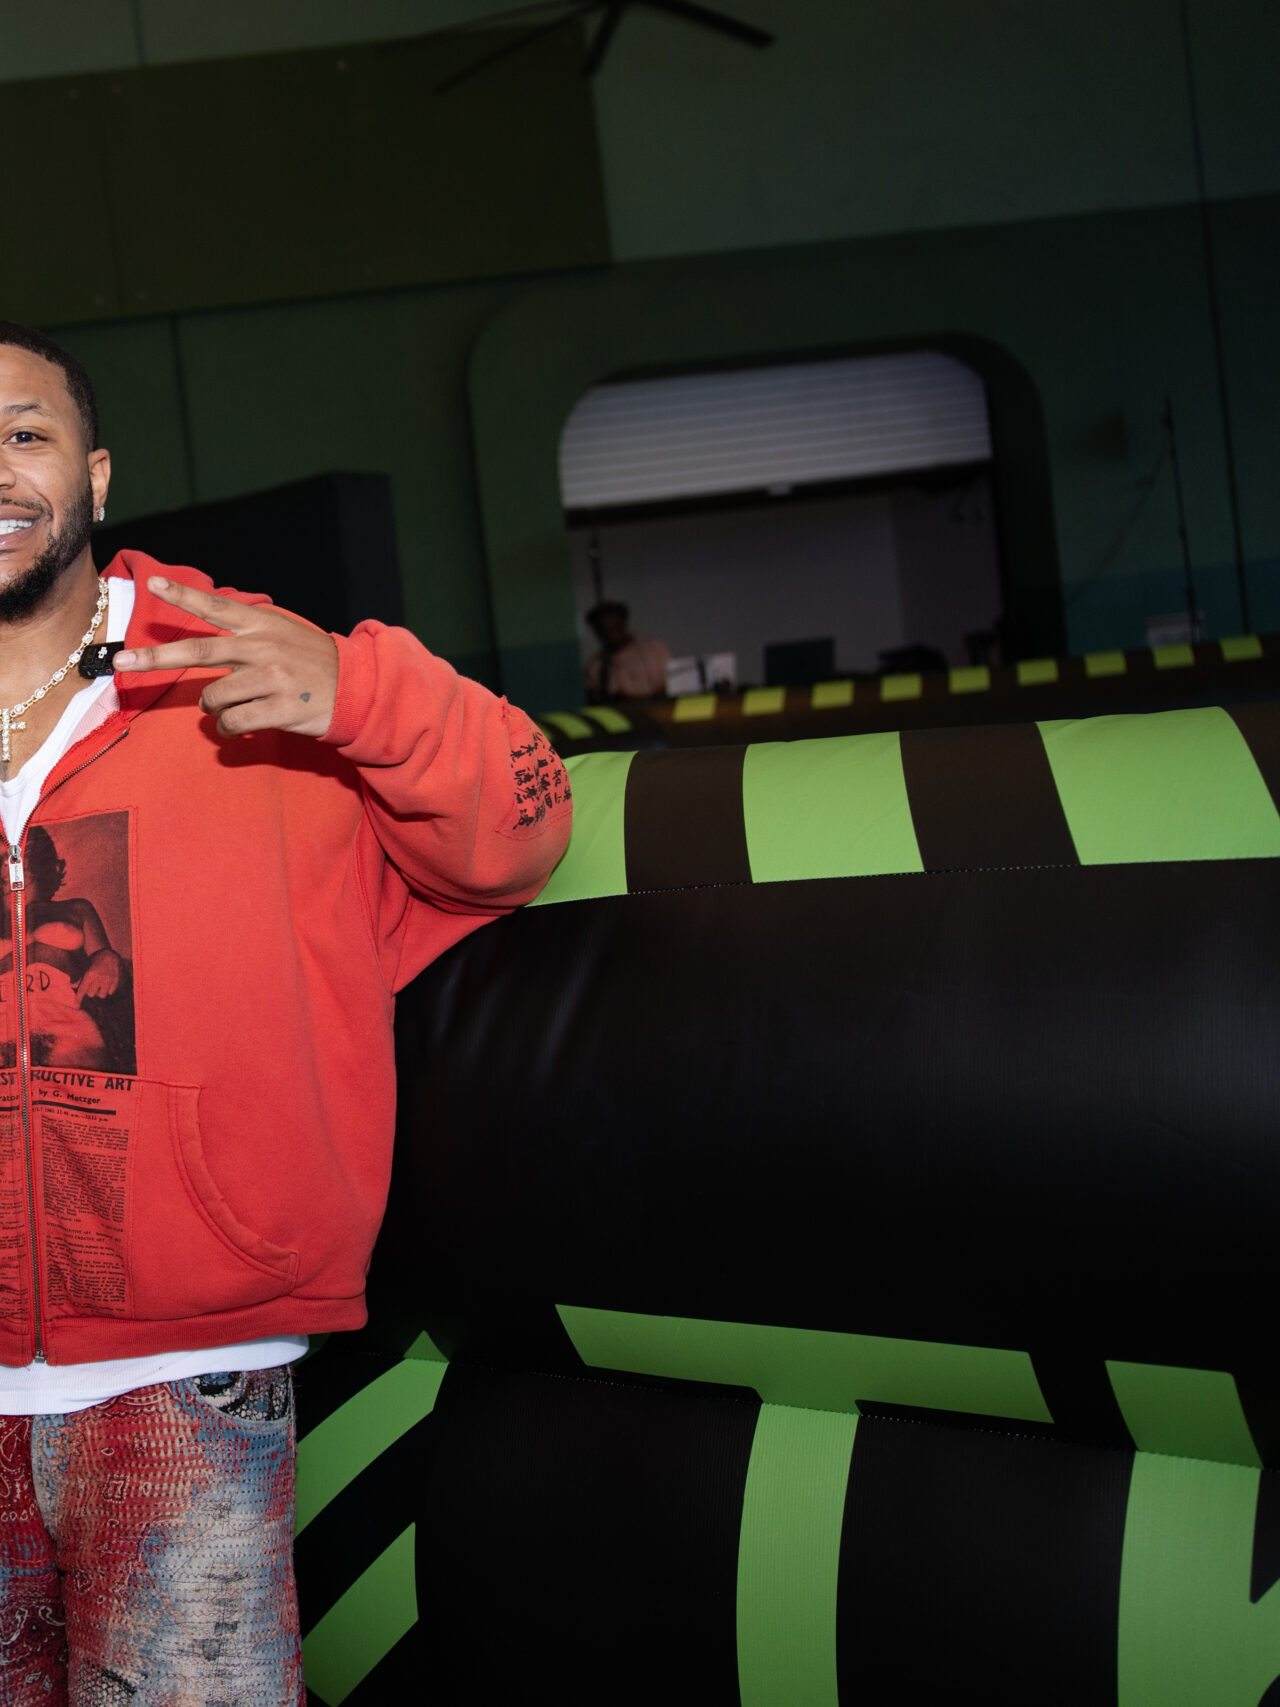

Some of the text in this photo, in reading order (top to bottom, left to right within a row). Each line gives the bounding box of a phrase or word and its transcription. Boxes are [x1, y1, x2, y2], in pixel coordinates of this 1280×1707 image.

[105, 1077, 135, 1091] ART
[39, 1088, 48, 1098] by
[67, 1093, 101, 1105] Metzger
